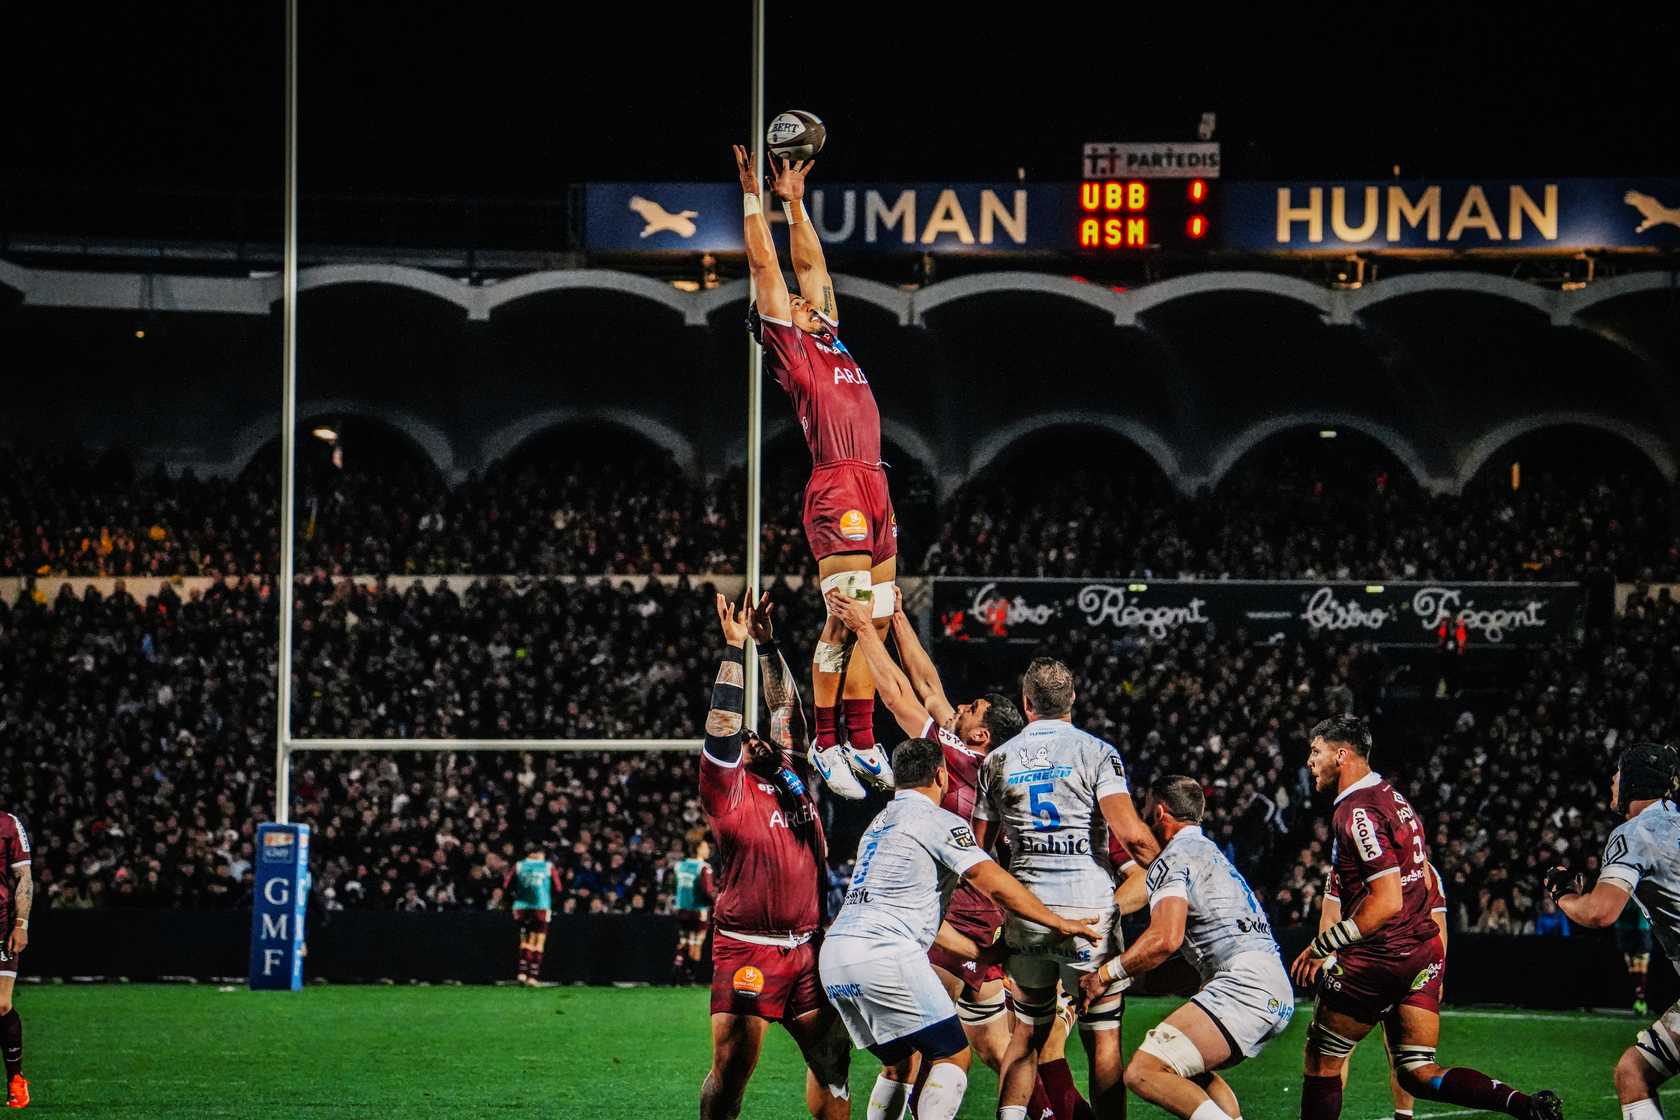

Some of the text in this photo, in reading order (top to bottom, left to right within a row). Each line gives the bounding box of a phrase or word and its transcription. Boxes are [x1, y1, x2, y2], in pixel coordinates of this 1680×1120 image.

[1127, 150, 1218, 167] PARTEDIS
[1082, 183, 1146, 210] UBB
[1276, 184, 1558, 244] HUMAN
[1081, 218, 1146, 246] ASM
[1077, 584, 1208, 640] Régent
[770, 802, 819, 828] ARLEA
[1029, 783, 1061, 833] 5
[1354, 810, 1377, 858] CACOLAC
[260, 877, 290, 976] GMF
